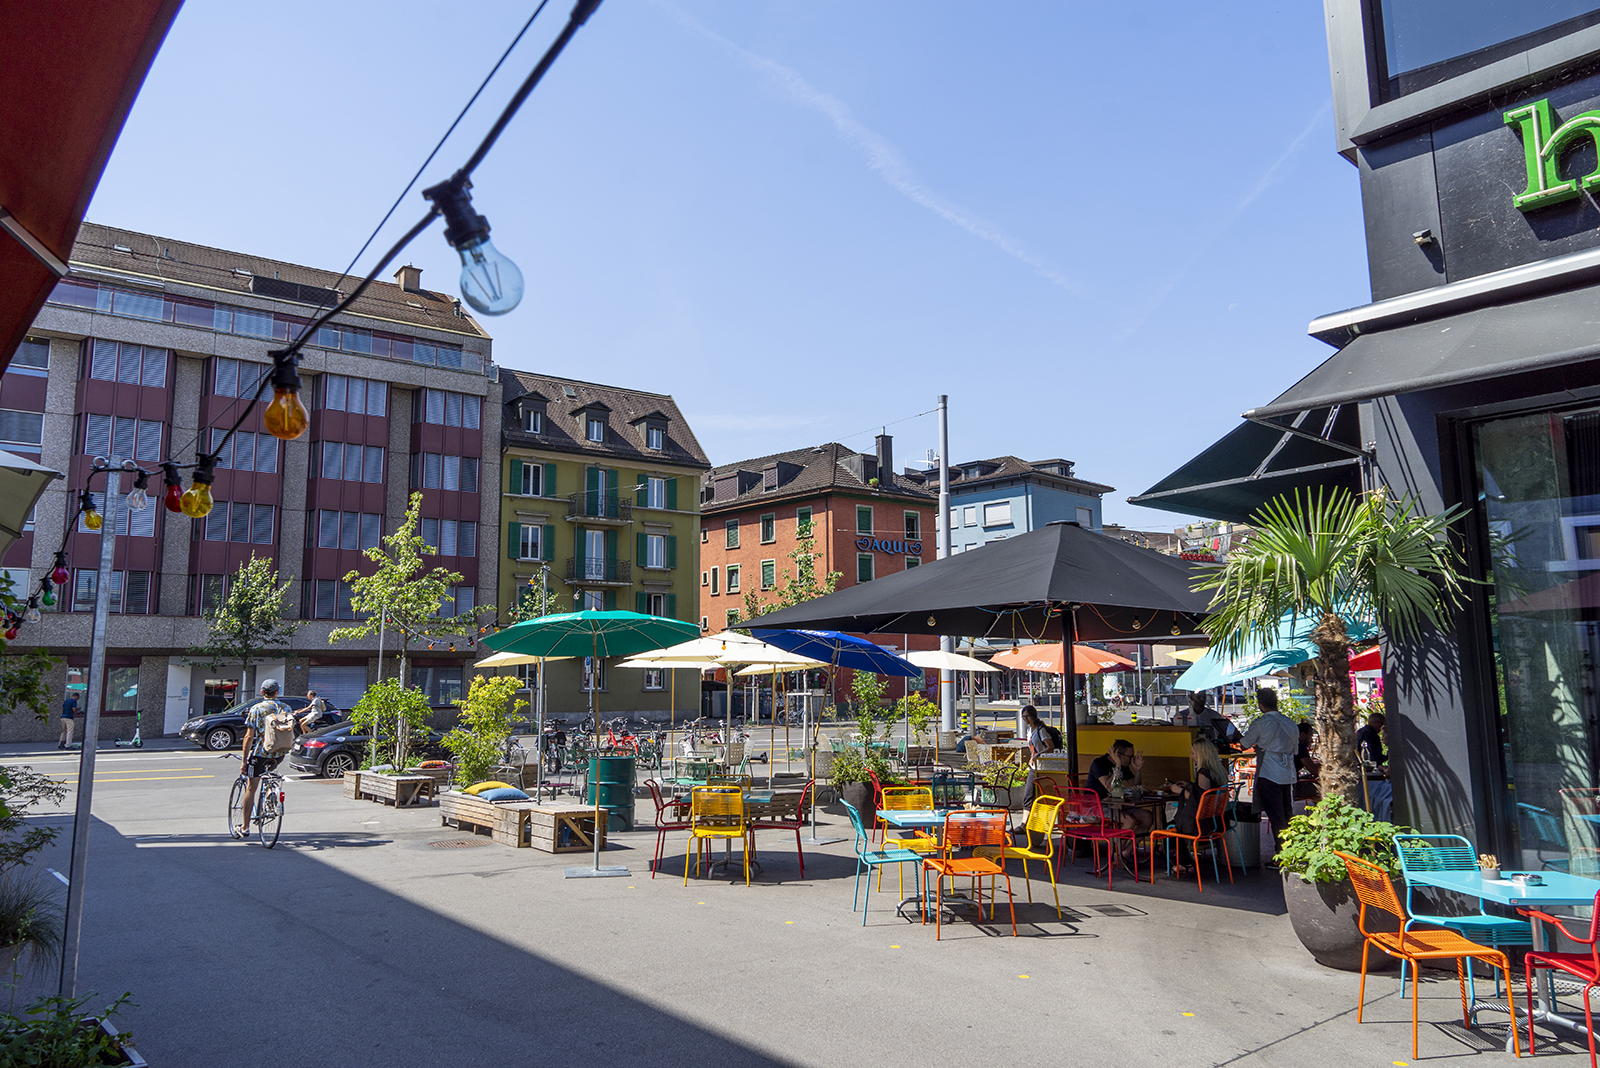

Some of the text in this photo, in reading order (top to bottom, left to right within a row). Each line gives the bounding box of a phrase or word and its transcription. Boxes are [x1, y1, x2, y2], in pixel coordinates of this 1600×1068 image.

[872, 539, 908, 555] AQUI
[1180, 553, 1217, 562] HONDA
[1026, 660, 1054, 668] NENI
